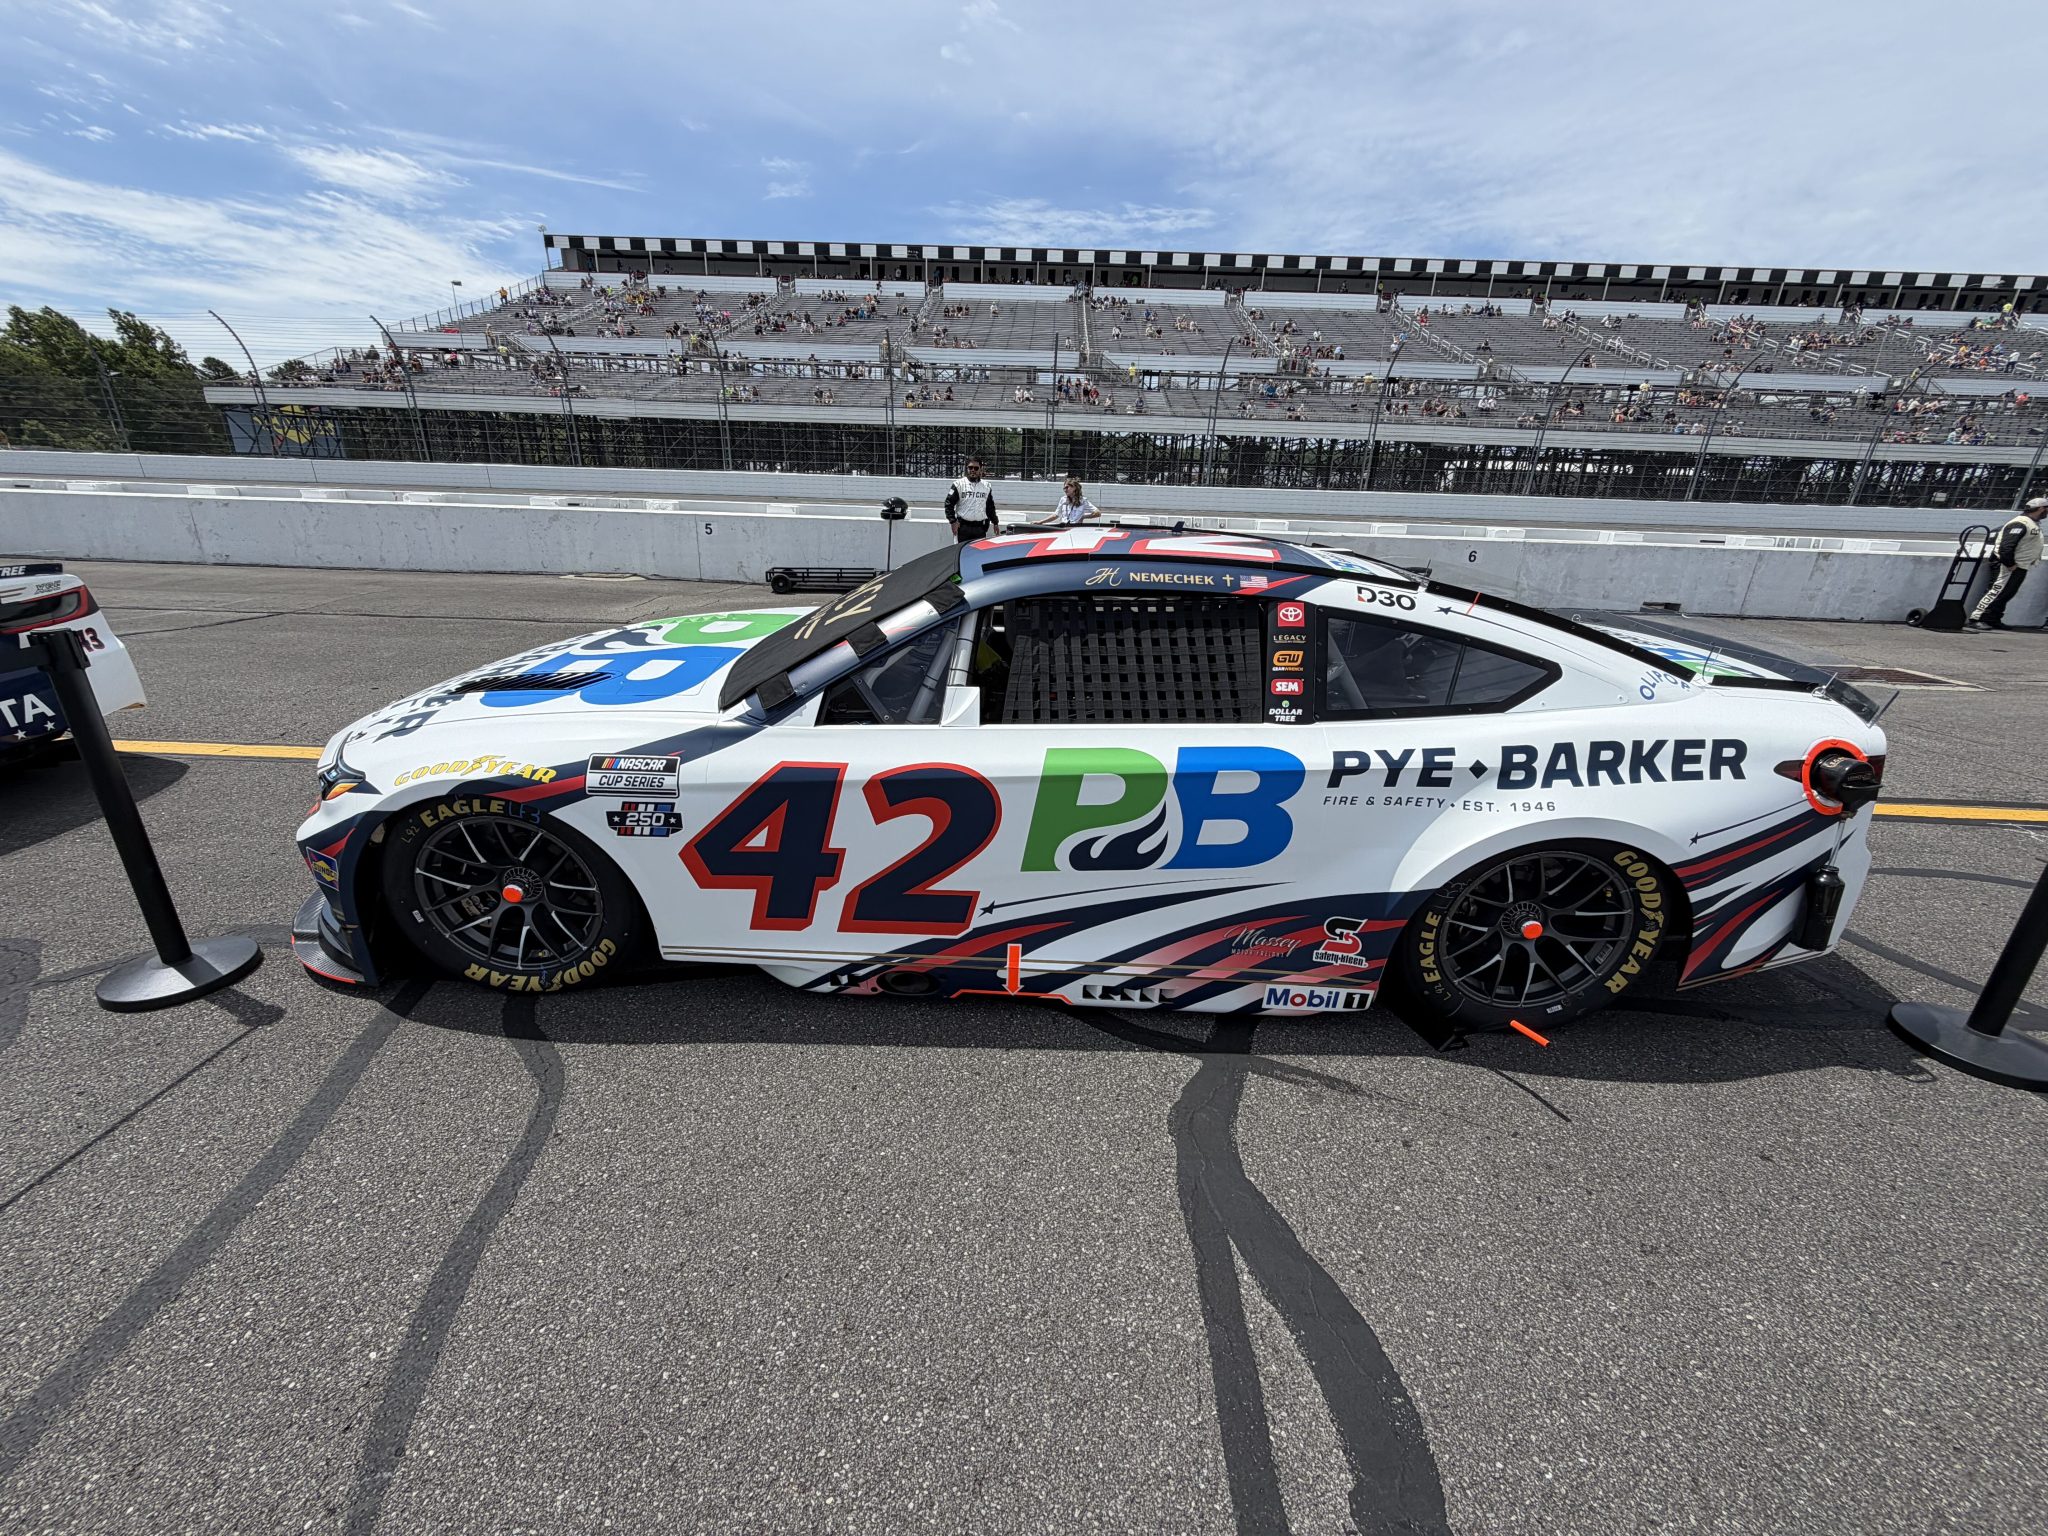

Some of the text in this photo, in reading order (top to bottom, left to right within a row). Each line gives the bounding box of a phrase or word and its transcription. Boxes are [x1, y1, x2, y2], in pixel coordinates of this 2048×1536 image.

[704, 522, 713, 535] 5
[1467, 549, 1477, 562] 6
[1129, 572, 1215, 585] NEMECHEK
[1277, 654, 1300, 663] GW
[1275, 681, 1299, 692] SEM
[1268, 708, 1303, 716] DOLLAR
[394, 754, 557, 787] GOODYEAR
[617, 758, 667, 771] NASCAR
[1327, 738, 1748, 790] PYE BARKER
[599, 775, 665, 788] CUP SERIES
[1323, 796, 1556, 813] FIRE & SAFETY EST. 1946
[419, 799, 506, 828] EAGLE
[625, 812, 665, 826] 250
[678, 760, 1002, 935] 42
[1604, 850, 1665, 994] GOODYEAR
[1224, 924, 1302, 957] Massey
[1420, 911, 1442, 983] EAGLE
[463, 938, 616, 992] GOODYEAR
[1265, 987, 1361, 1009] Mobil 1
